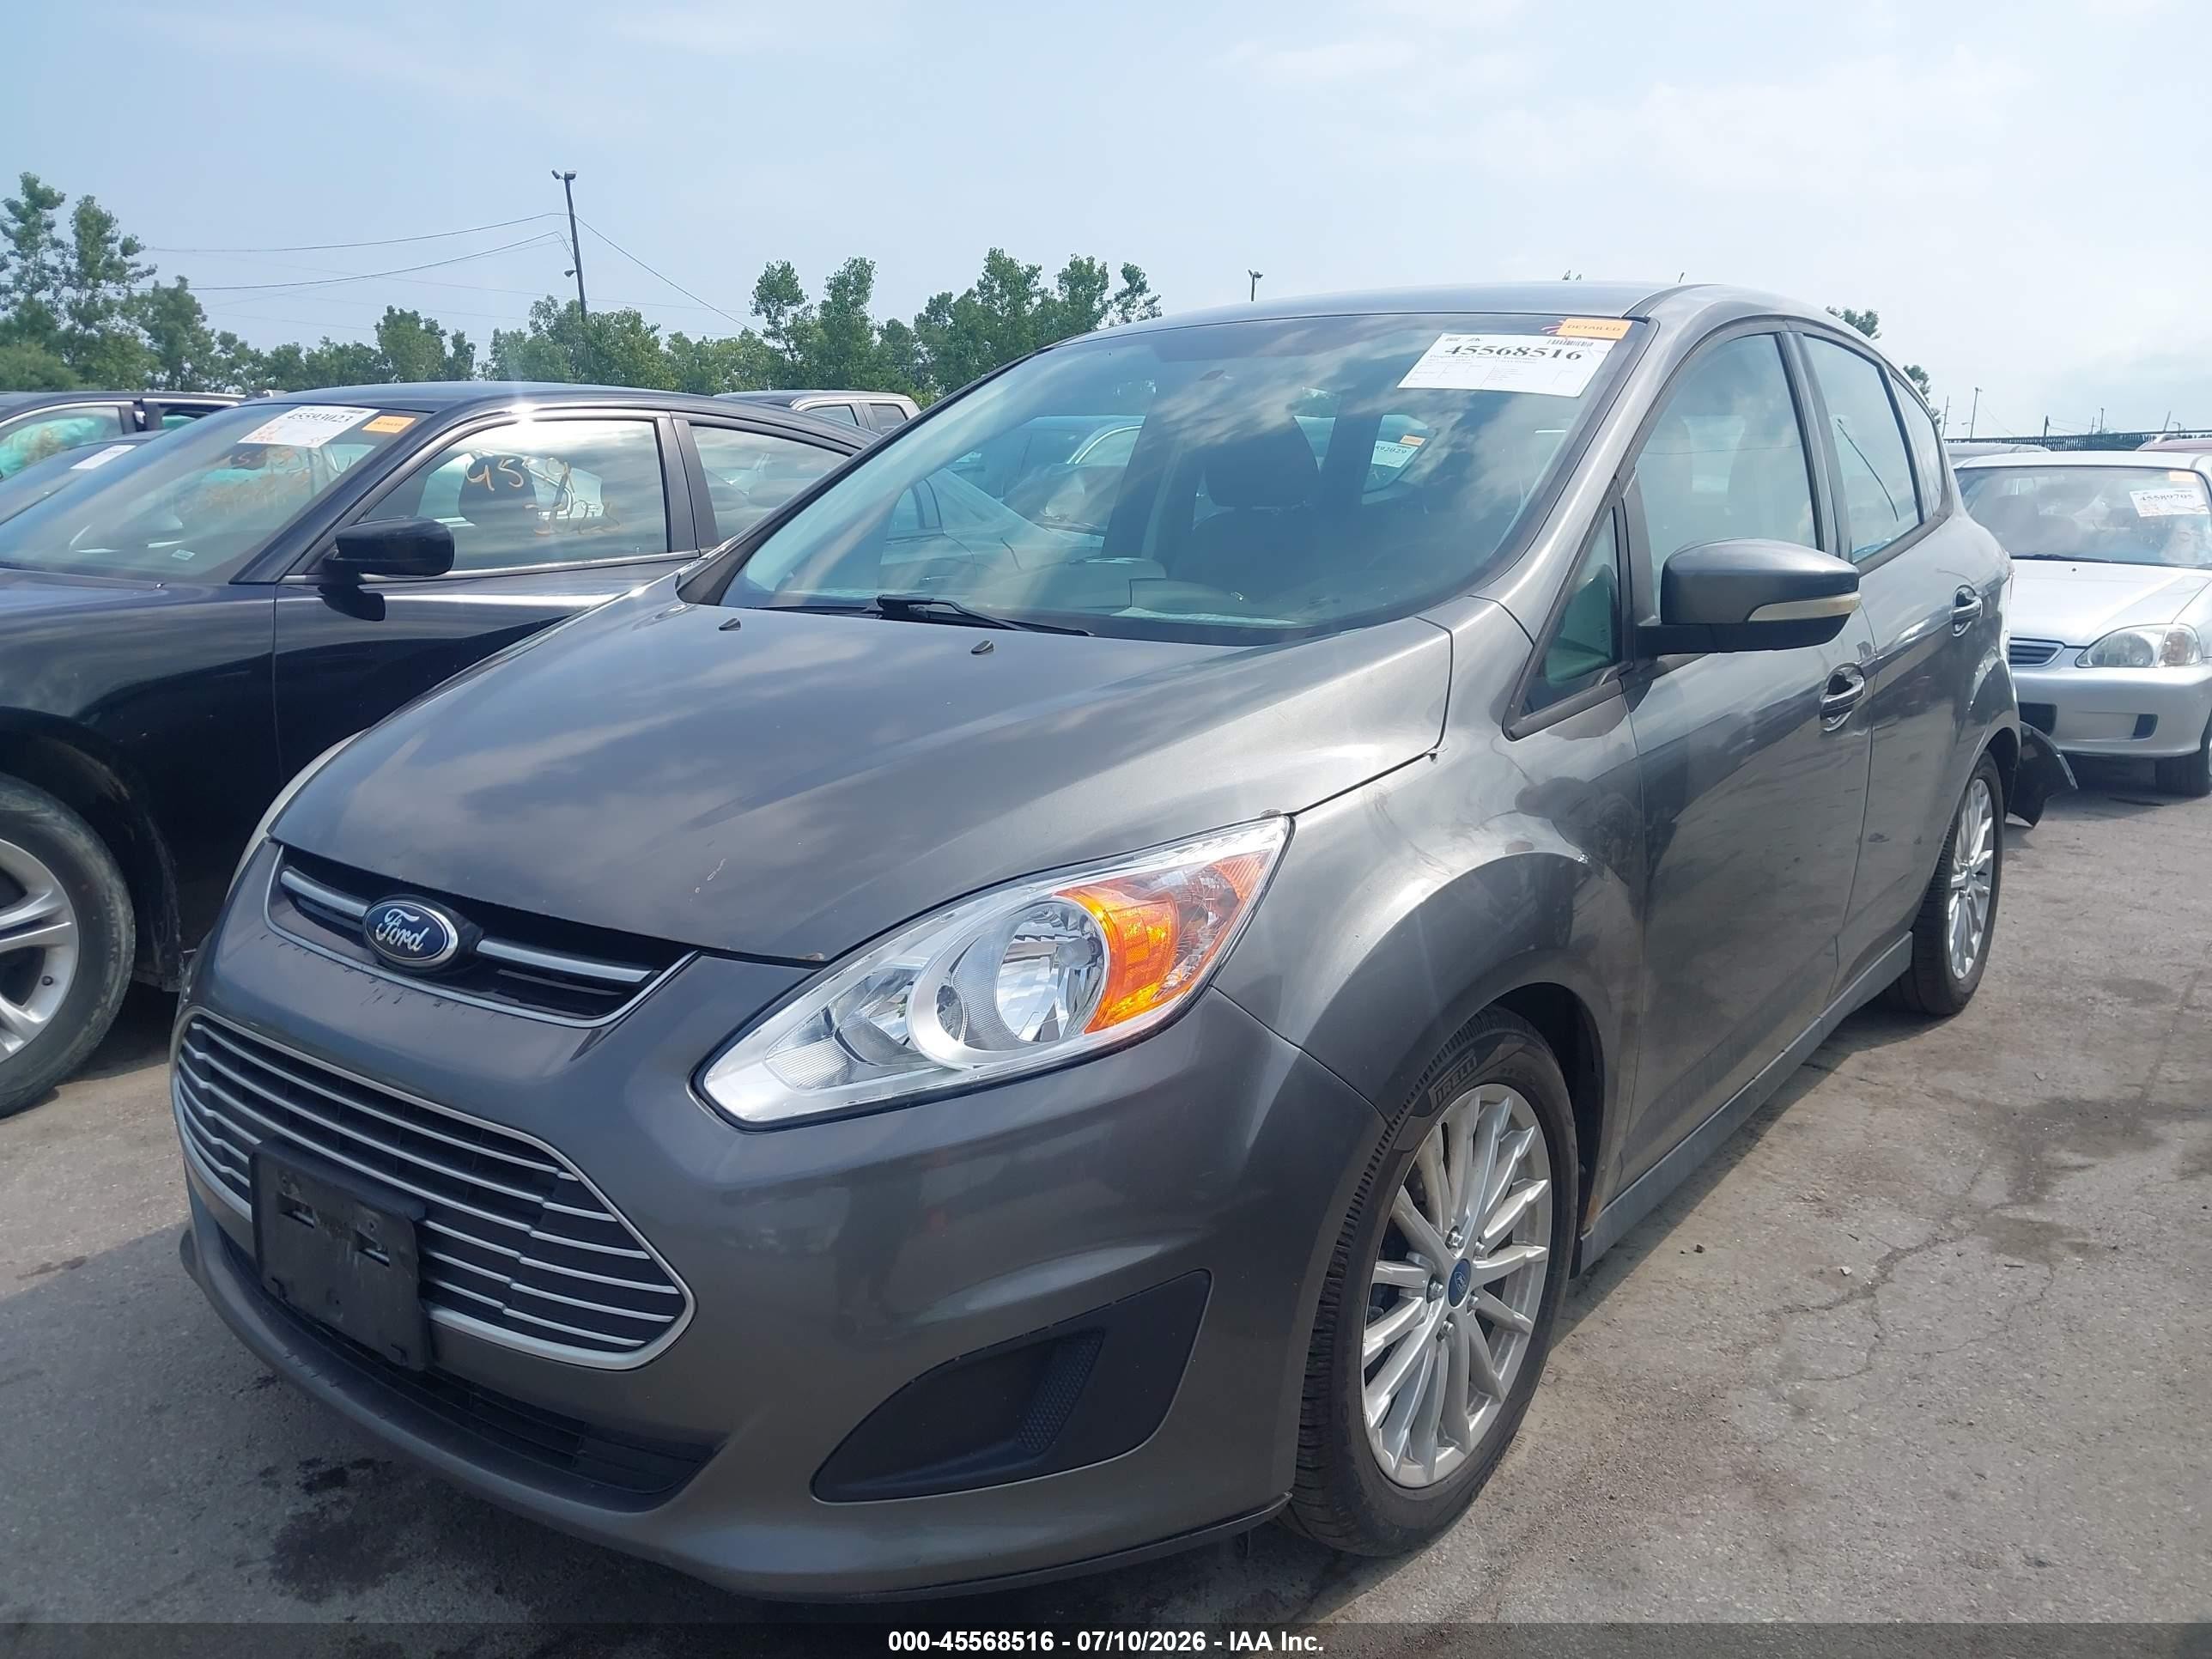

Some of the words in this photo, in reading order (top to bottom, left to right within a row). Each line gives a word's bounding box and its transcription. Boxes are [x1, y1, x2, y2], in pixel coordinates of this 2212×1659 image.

[1444, 344, 1583, 362] 45568516
[376, 908, 429, 952] Ford
[1428, 1048, 1478, 1110] PIRELLI
